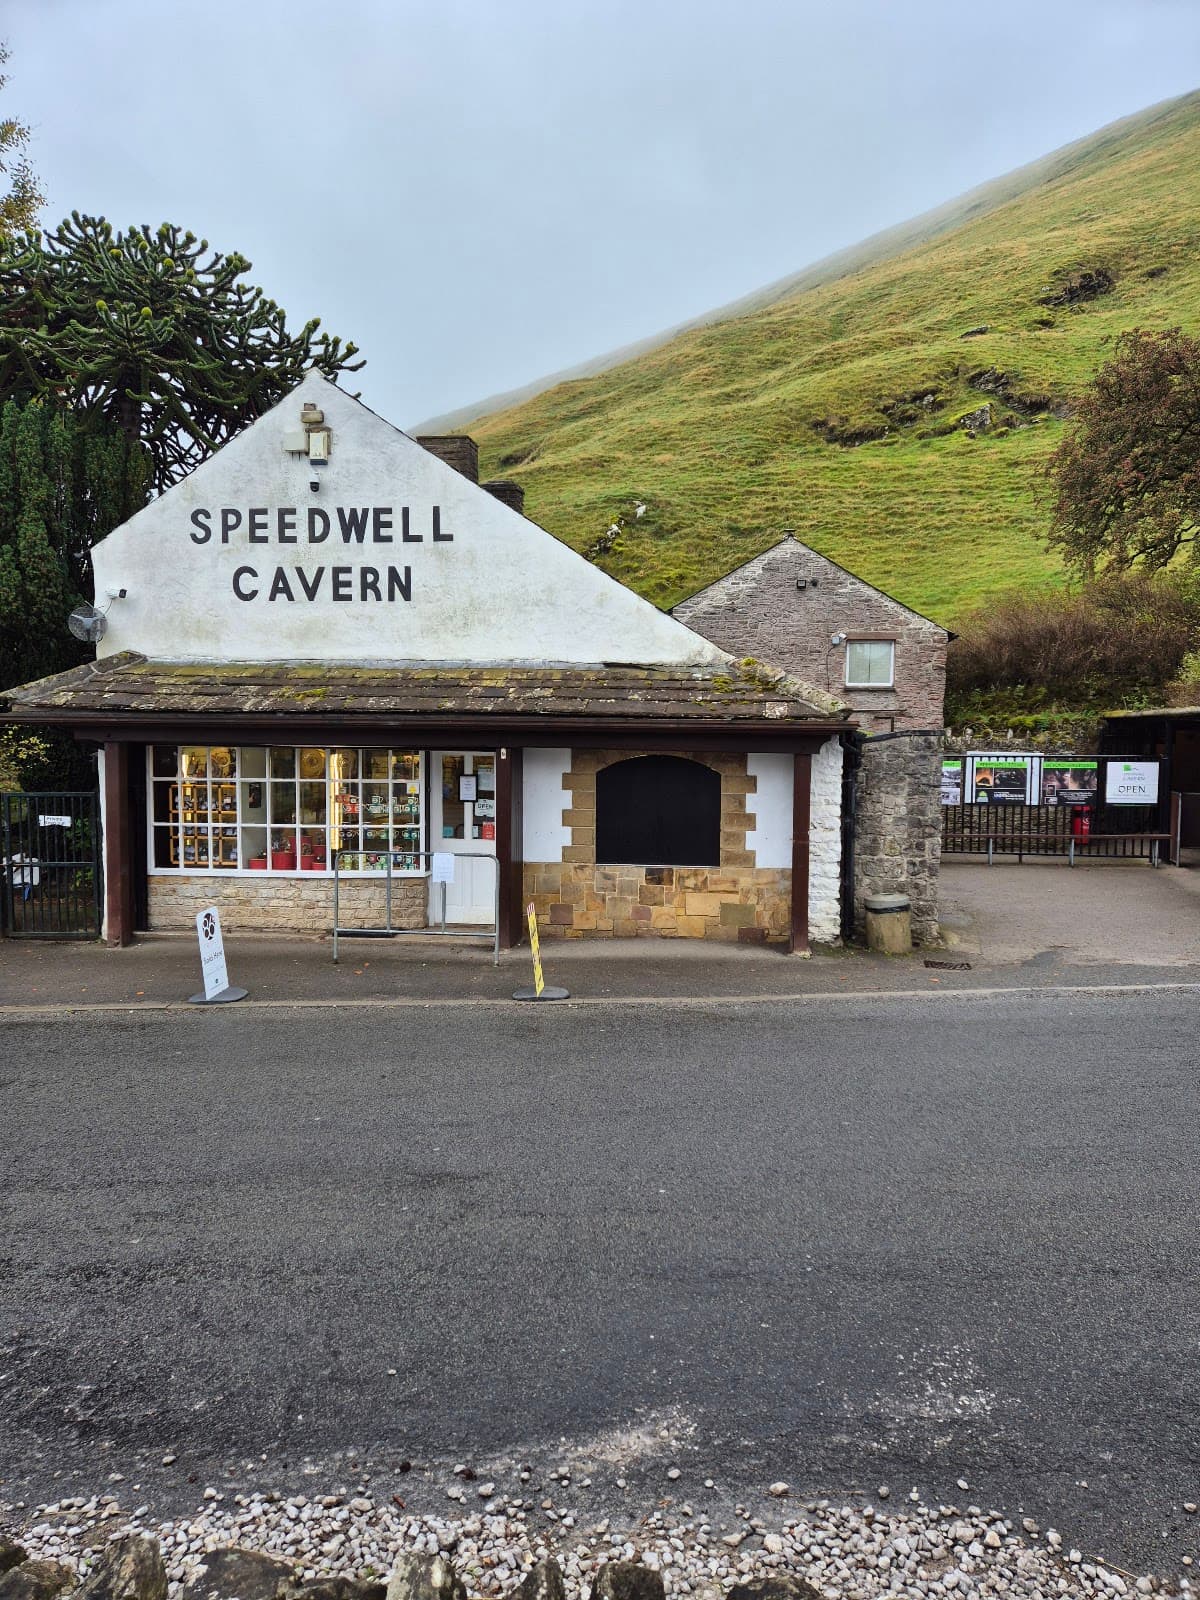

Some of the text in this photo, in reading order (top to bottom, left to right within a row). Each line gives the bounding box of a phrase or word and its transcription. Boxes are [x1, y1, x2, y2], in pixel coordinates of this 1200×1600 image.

[190, 506, 454, 544] SPEEDWELL
[232, 566, 412, 601] CAVERN
[1118, 785, 1146, 793] OPEN
